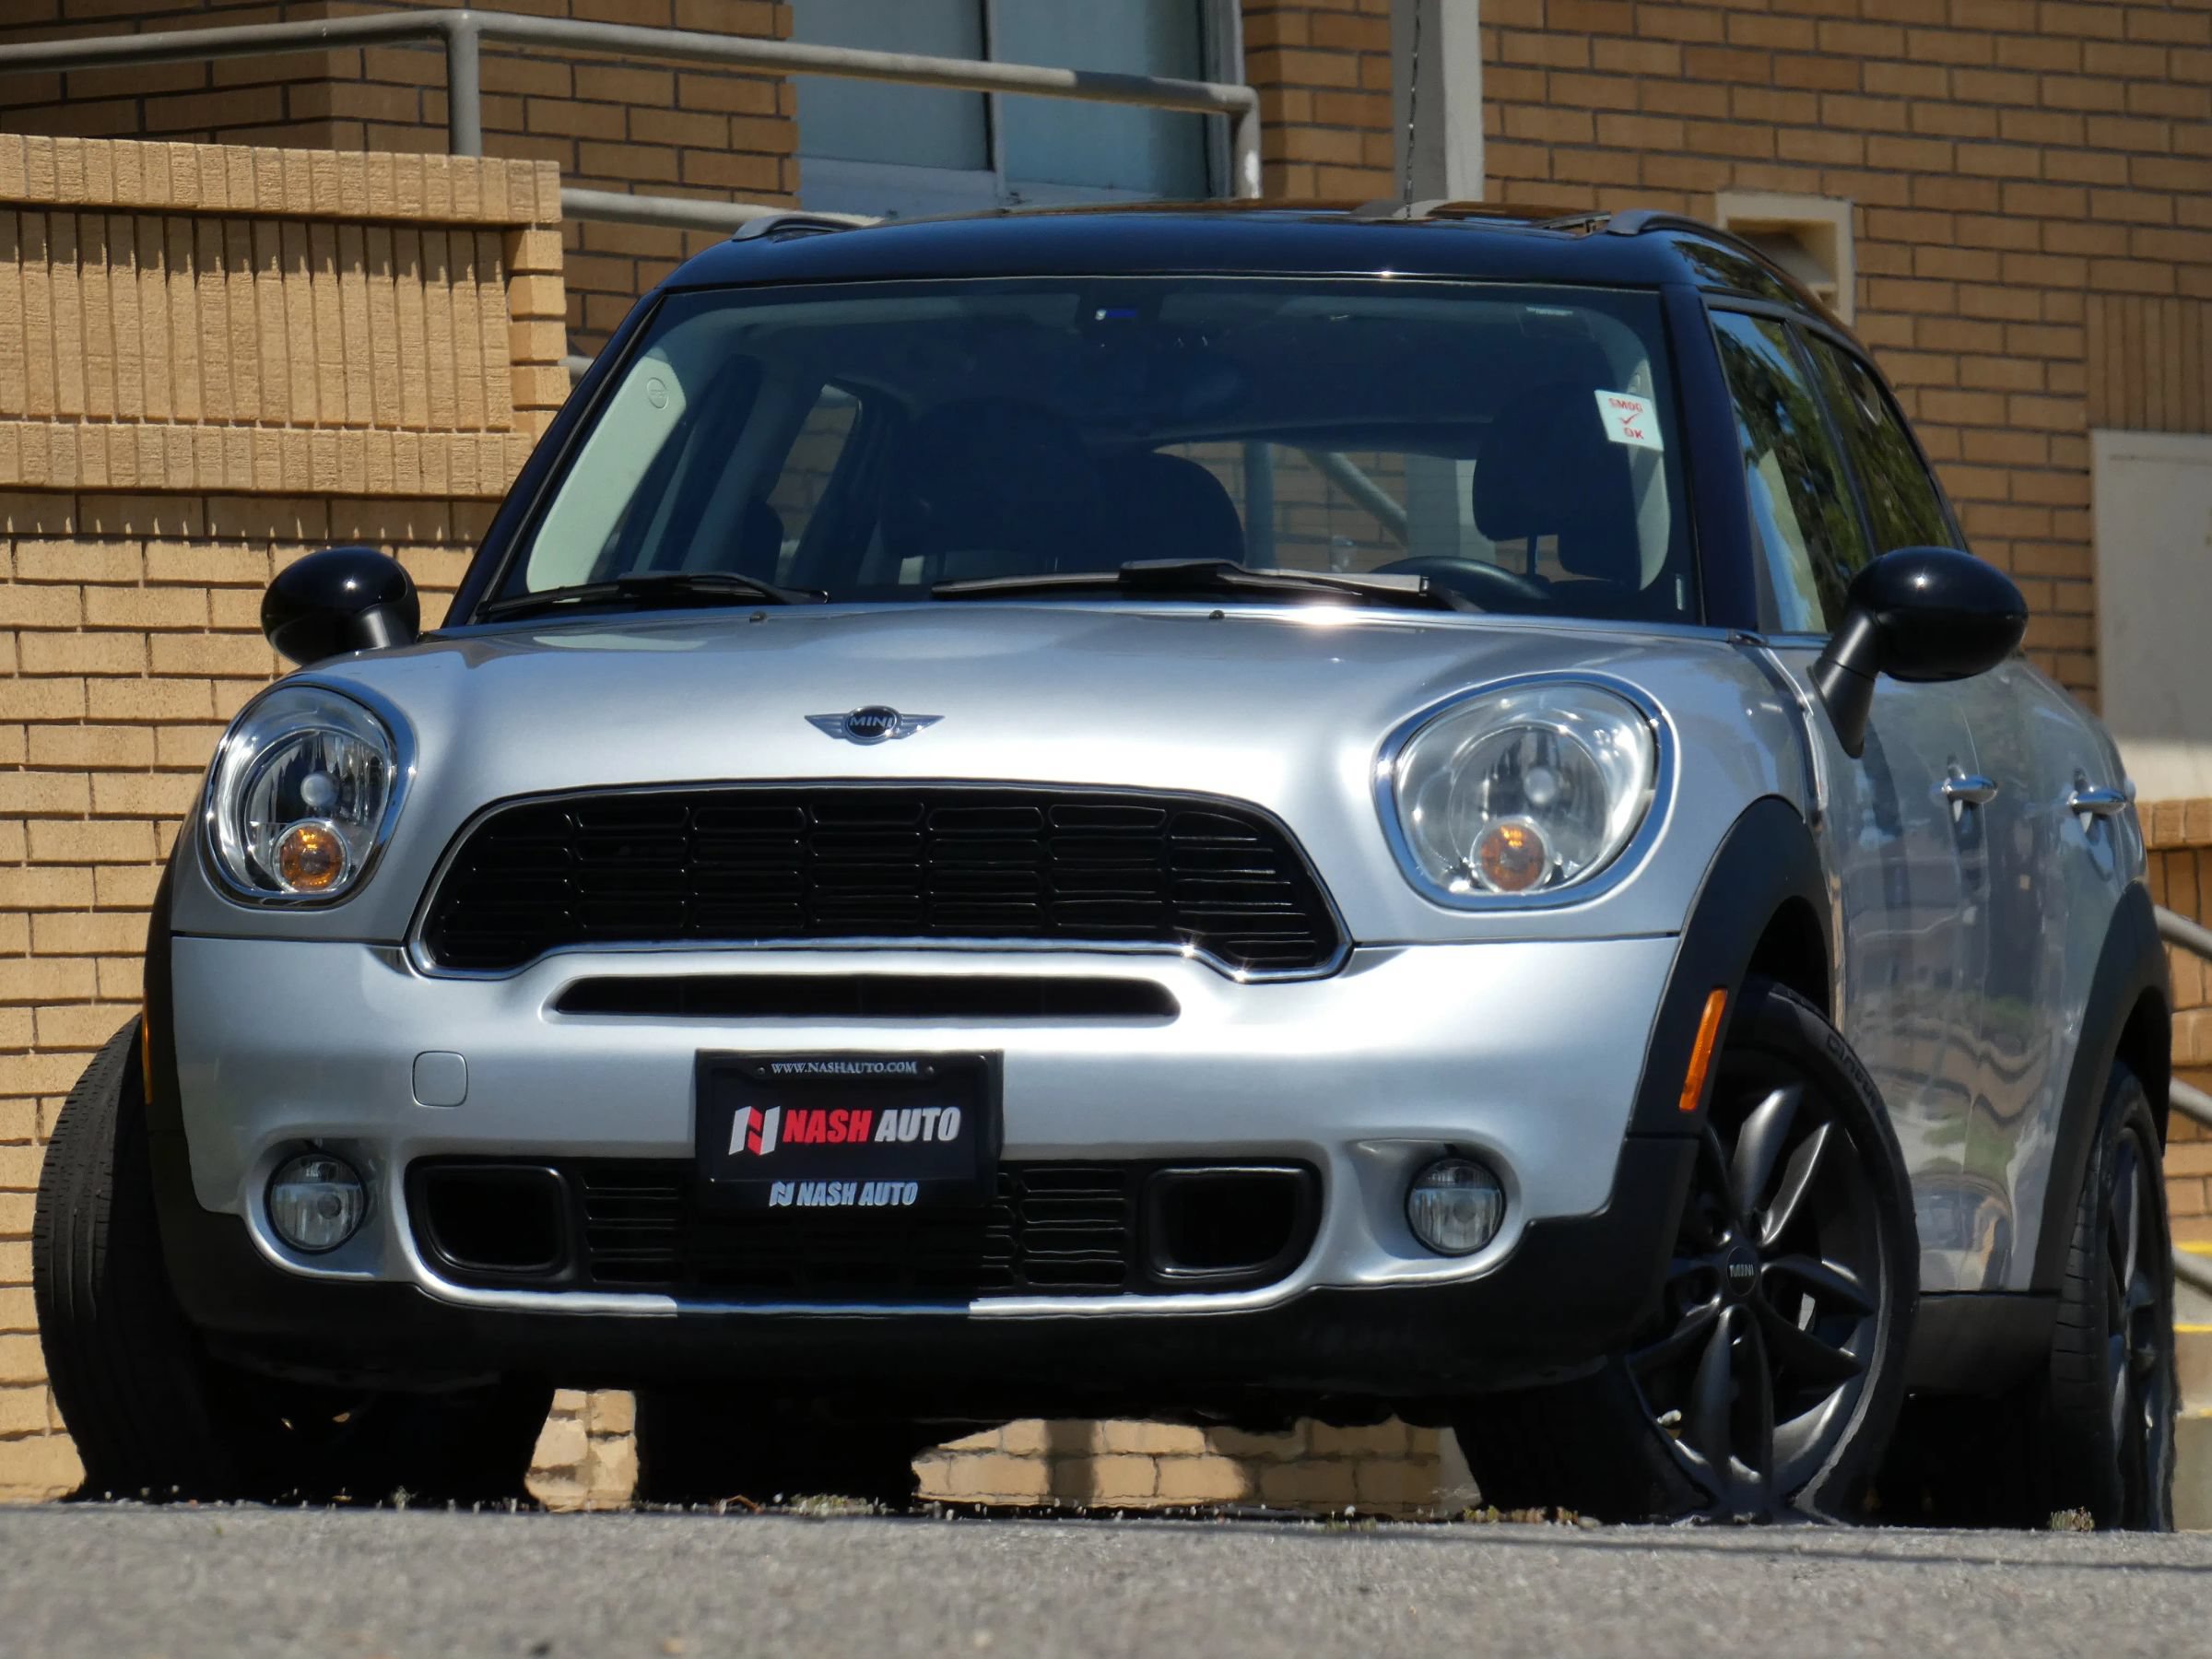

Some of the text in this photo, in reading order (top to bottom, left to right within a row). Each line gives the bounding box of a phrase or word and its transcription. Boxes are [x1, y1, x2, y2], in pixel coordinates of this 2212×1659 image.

[1608, 397, 1643, 413] SMOG
[1623, 427, 1644, 440] OK
[849, 715, 894, 728] MINI
[771, 1061, 918, 1074] WWW.NASHAUTO.COM
[782, 1109, 873, 1143] NASH
[874, 1107, 961, 1142] AUTO
[796, 1182, 858, 1206] NASH
[858, 1182, 919, 1206] AUTO
[1729, 1264, 1754, 1277] MINI
